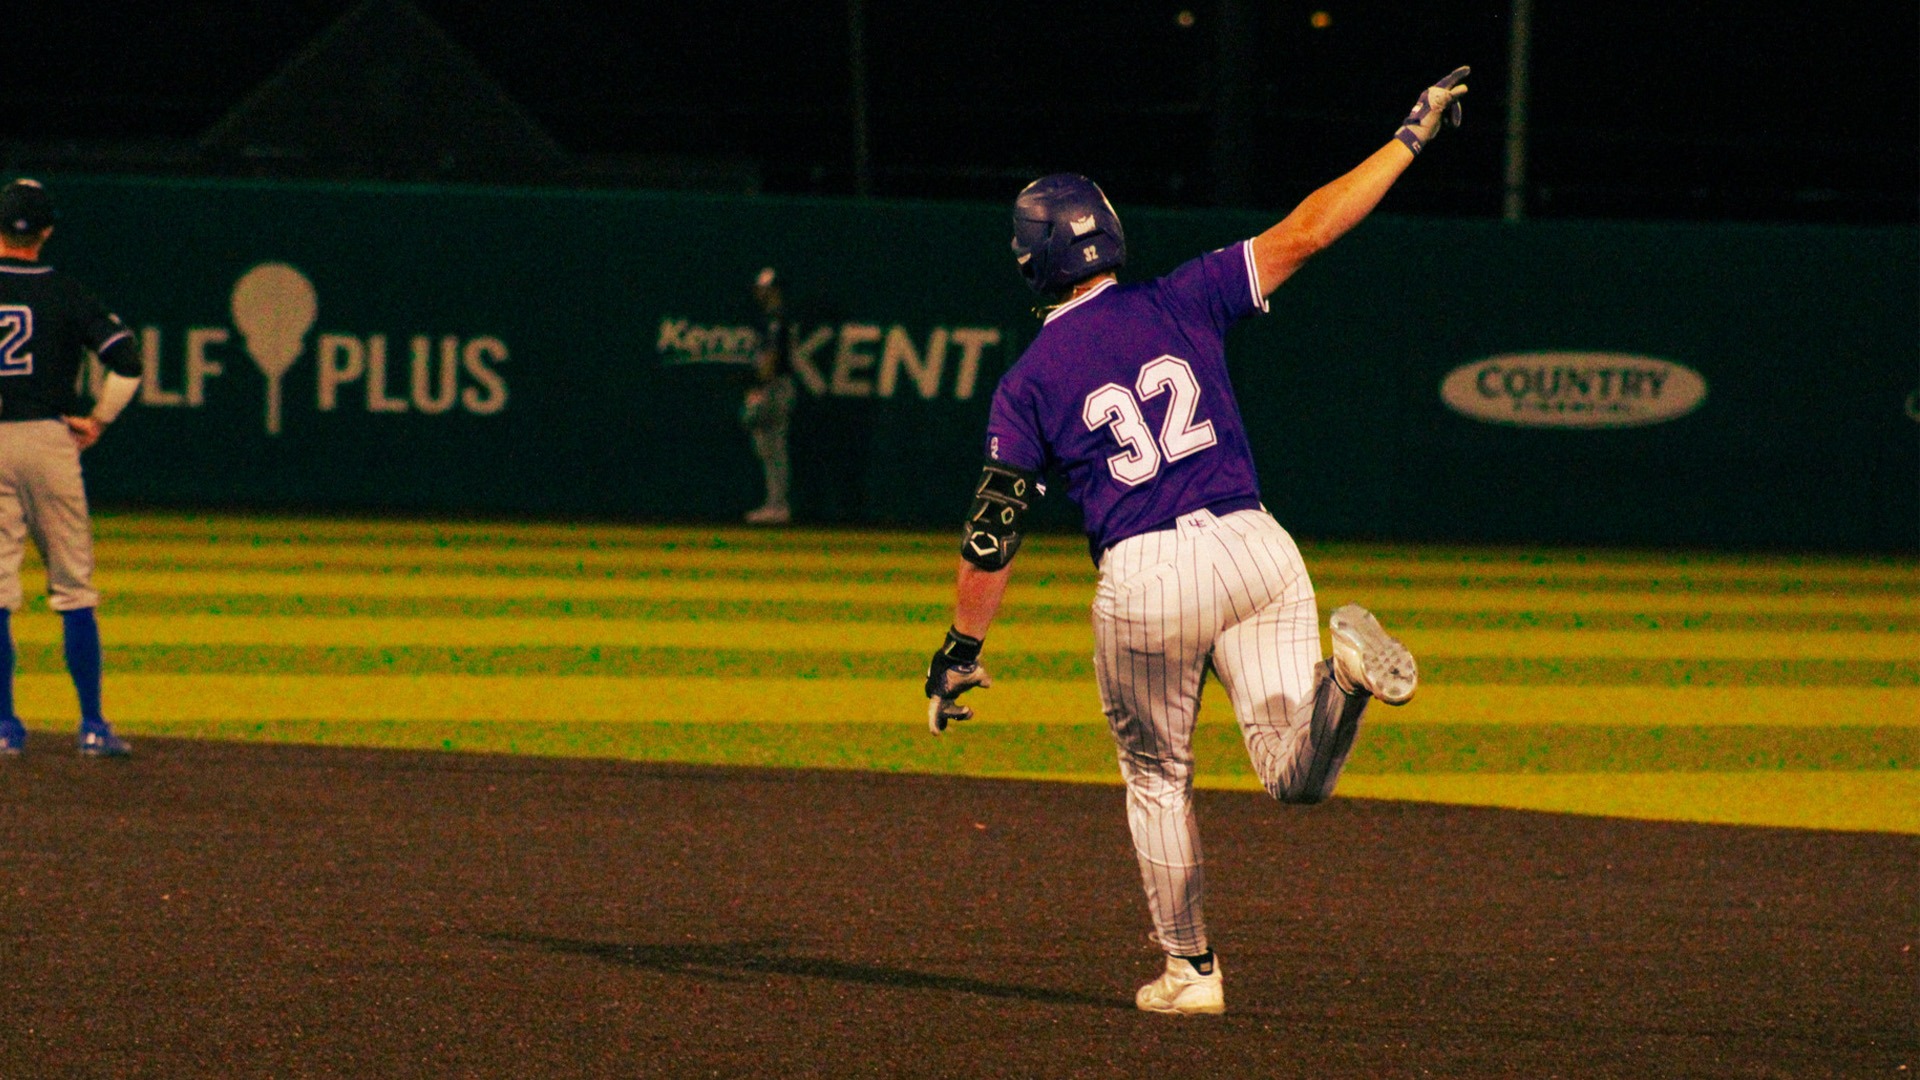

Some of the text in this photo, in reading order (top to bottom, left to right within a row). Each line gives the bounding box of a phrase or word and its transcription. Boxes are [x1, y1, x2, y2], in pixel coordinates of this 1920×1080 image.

[1083, 245, 1099, 262] 32
[73, 326, 510, 414] LF PLUS
[789, 321, 1000, 400] KENT
[1476, 365, 1671, 399] COUNTRY
[1081, 353, 1218, 486] 32
